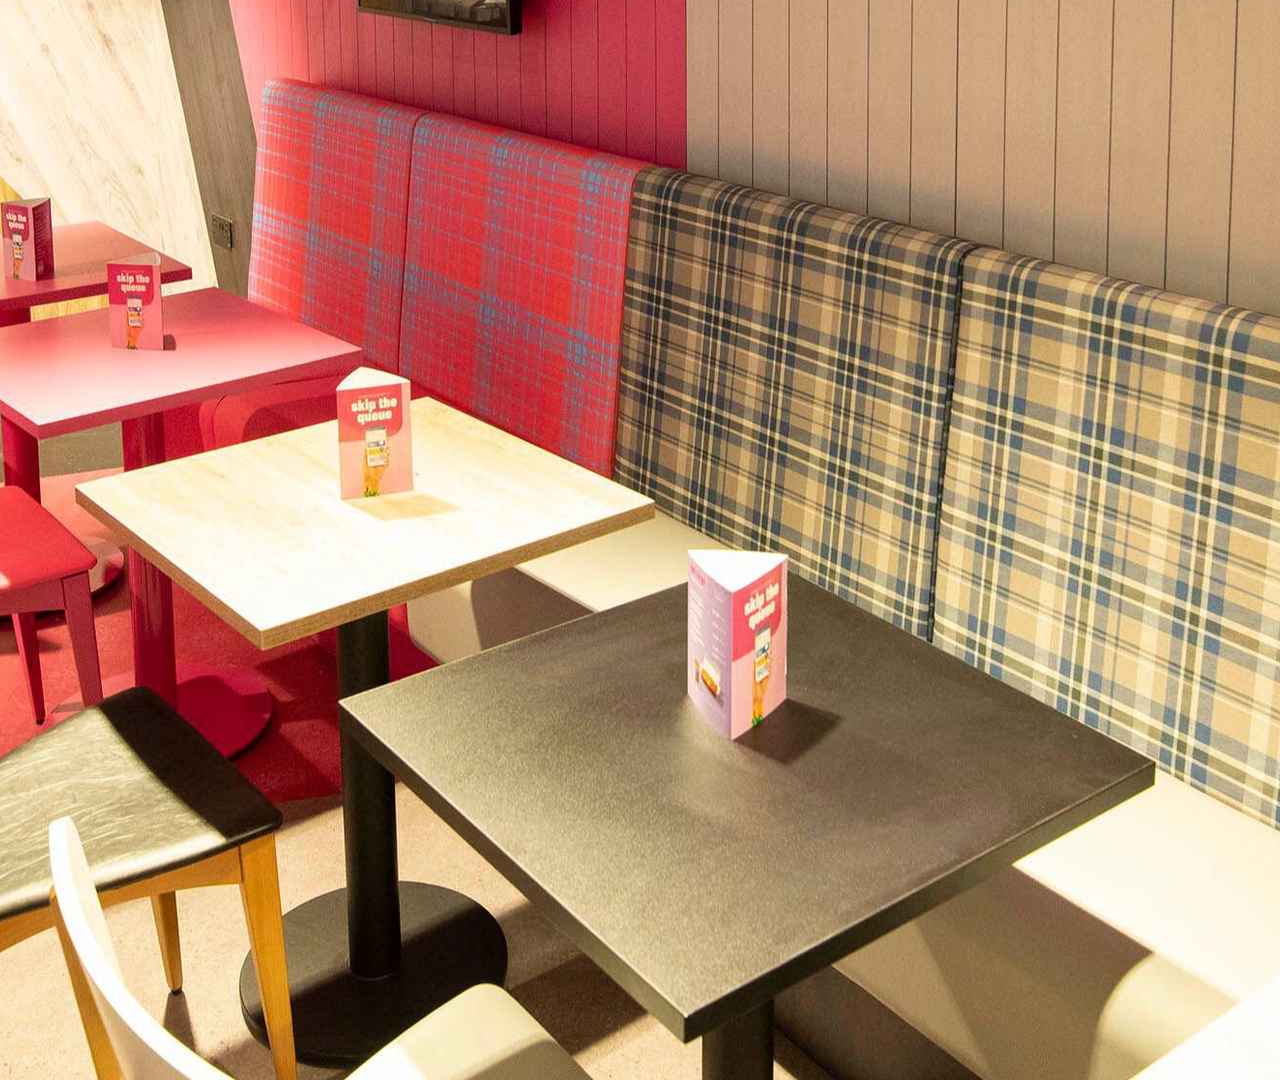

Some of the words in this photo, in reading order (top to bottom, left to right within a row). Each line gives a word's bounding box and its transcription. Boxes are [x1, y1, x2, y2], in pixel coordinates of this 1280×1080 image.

[6, 212, 18, 223] skip
[18, 214, 27, 223] the
[8, 221, 25, 230] queue
[116, 272, 135, 285] skip
[136, 274, 151, 284] the
[120, 283, 147, 294] queue
[351, 398, 377, 414] skip
[378, 396, 398, 409] the
[357, 410, 393, 426] queue
[744, 592, 765, 617] skip
[765, 582, 780, 602] the
[749, 600, 776, 631] queue
